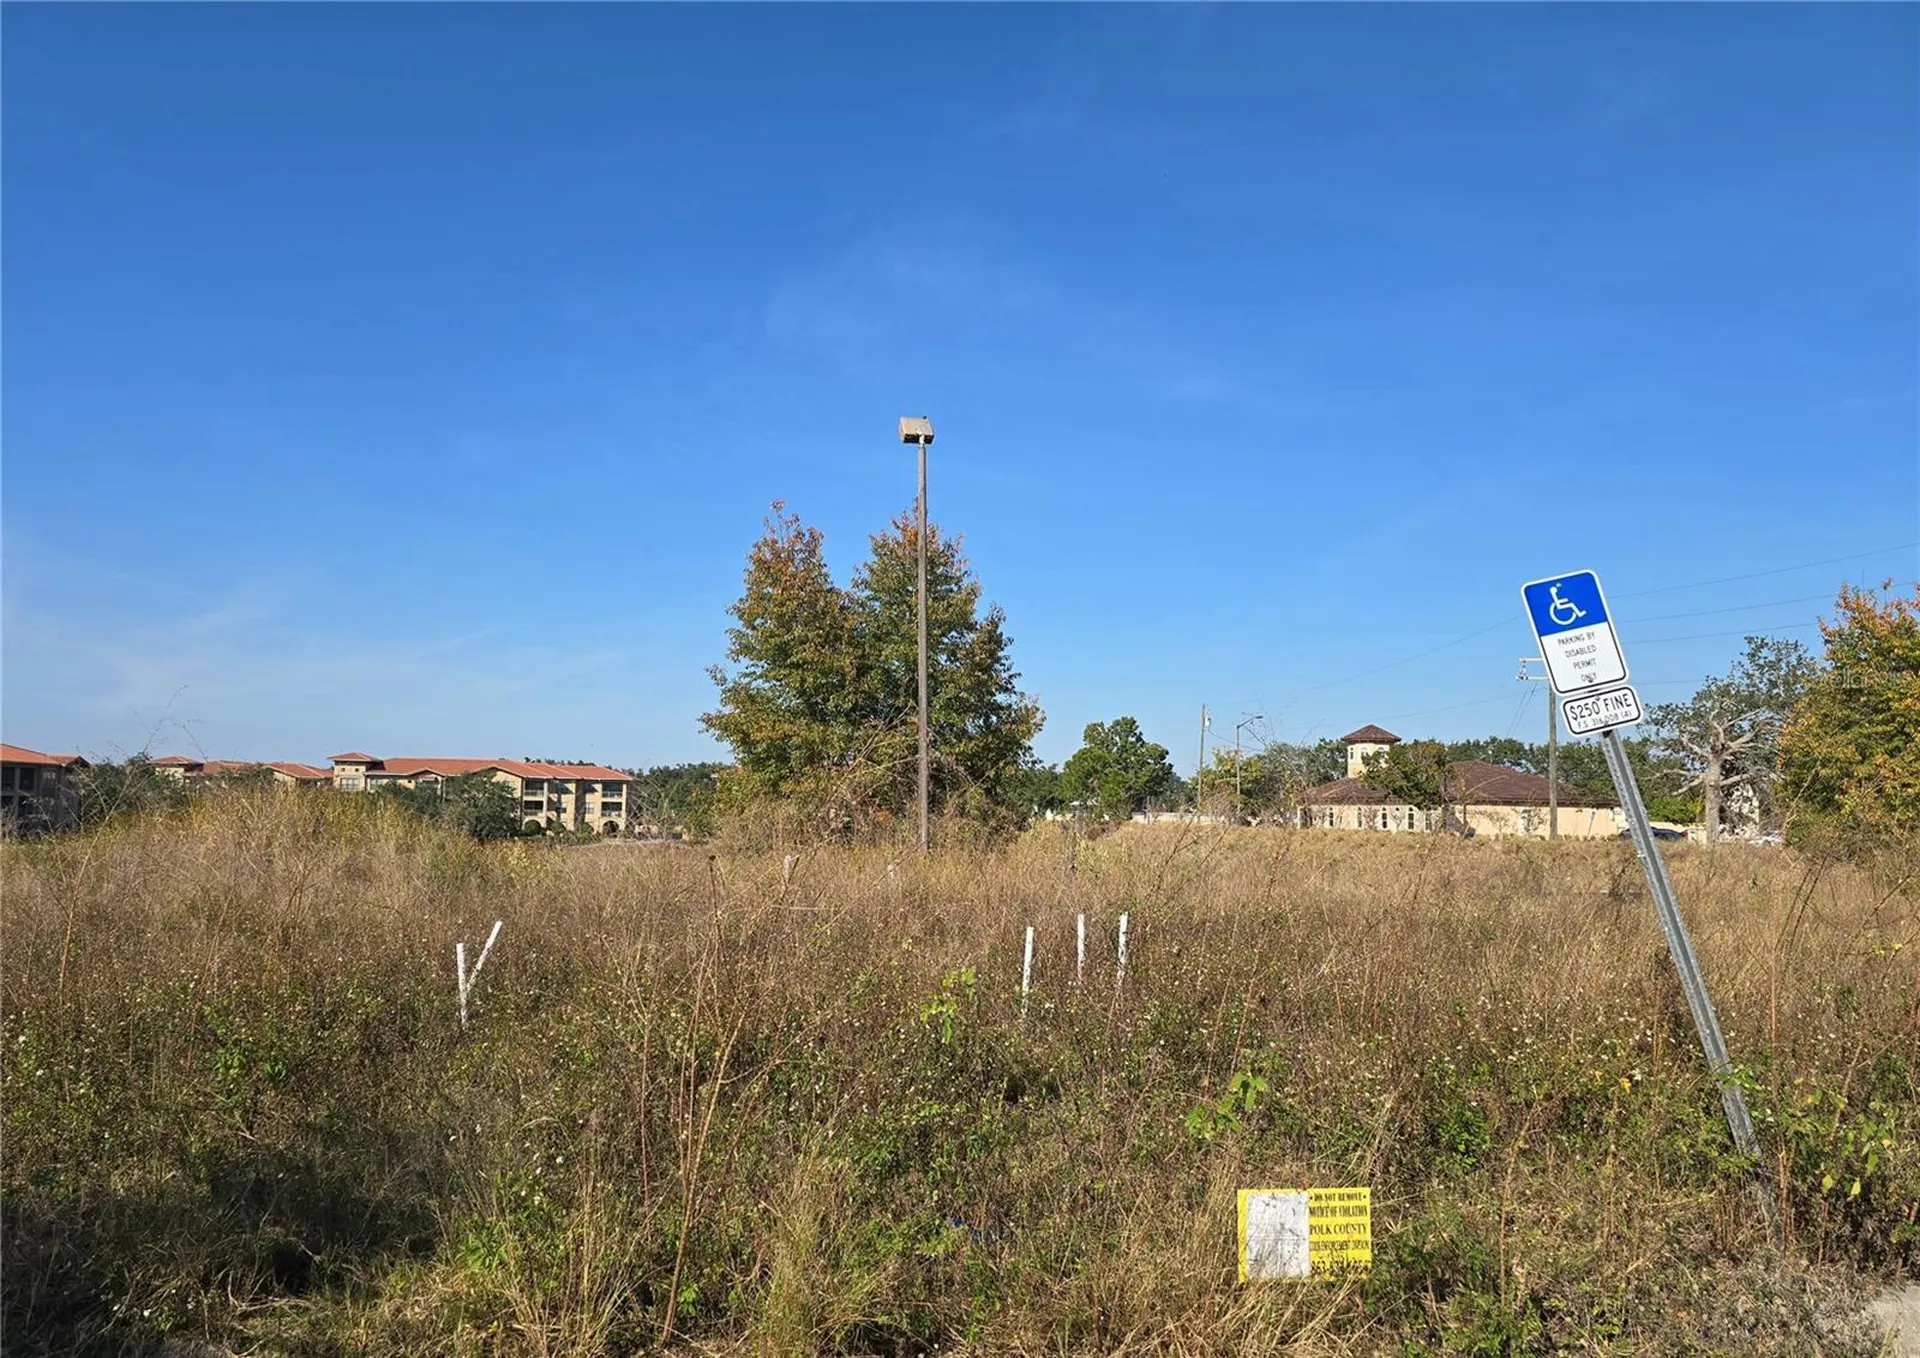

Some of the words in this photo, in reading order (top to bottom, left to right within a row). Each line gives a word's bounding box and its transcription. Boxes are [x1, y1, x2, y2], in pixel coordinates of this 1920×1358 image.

[1586, 631, 1596, 640] BY
[1565, 644, 1597, 658] DISABLED
[1572, 658, 1597, 669] PERMIT
[1580, 672, 1597, 682] ONLY
[1569, 701, 1601, 721] $250
[1603, 693, 1632, 712] FINE
[1309, 1223, 1332, 1235] POLK
[1333, 1222, 1367, 1234] COUNTY
